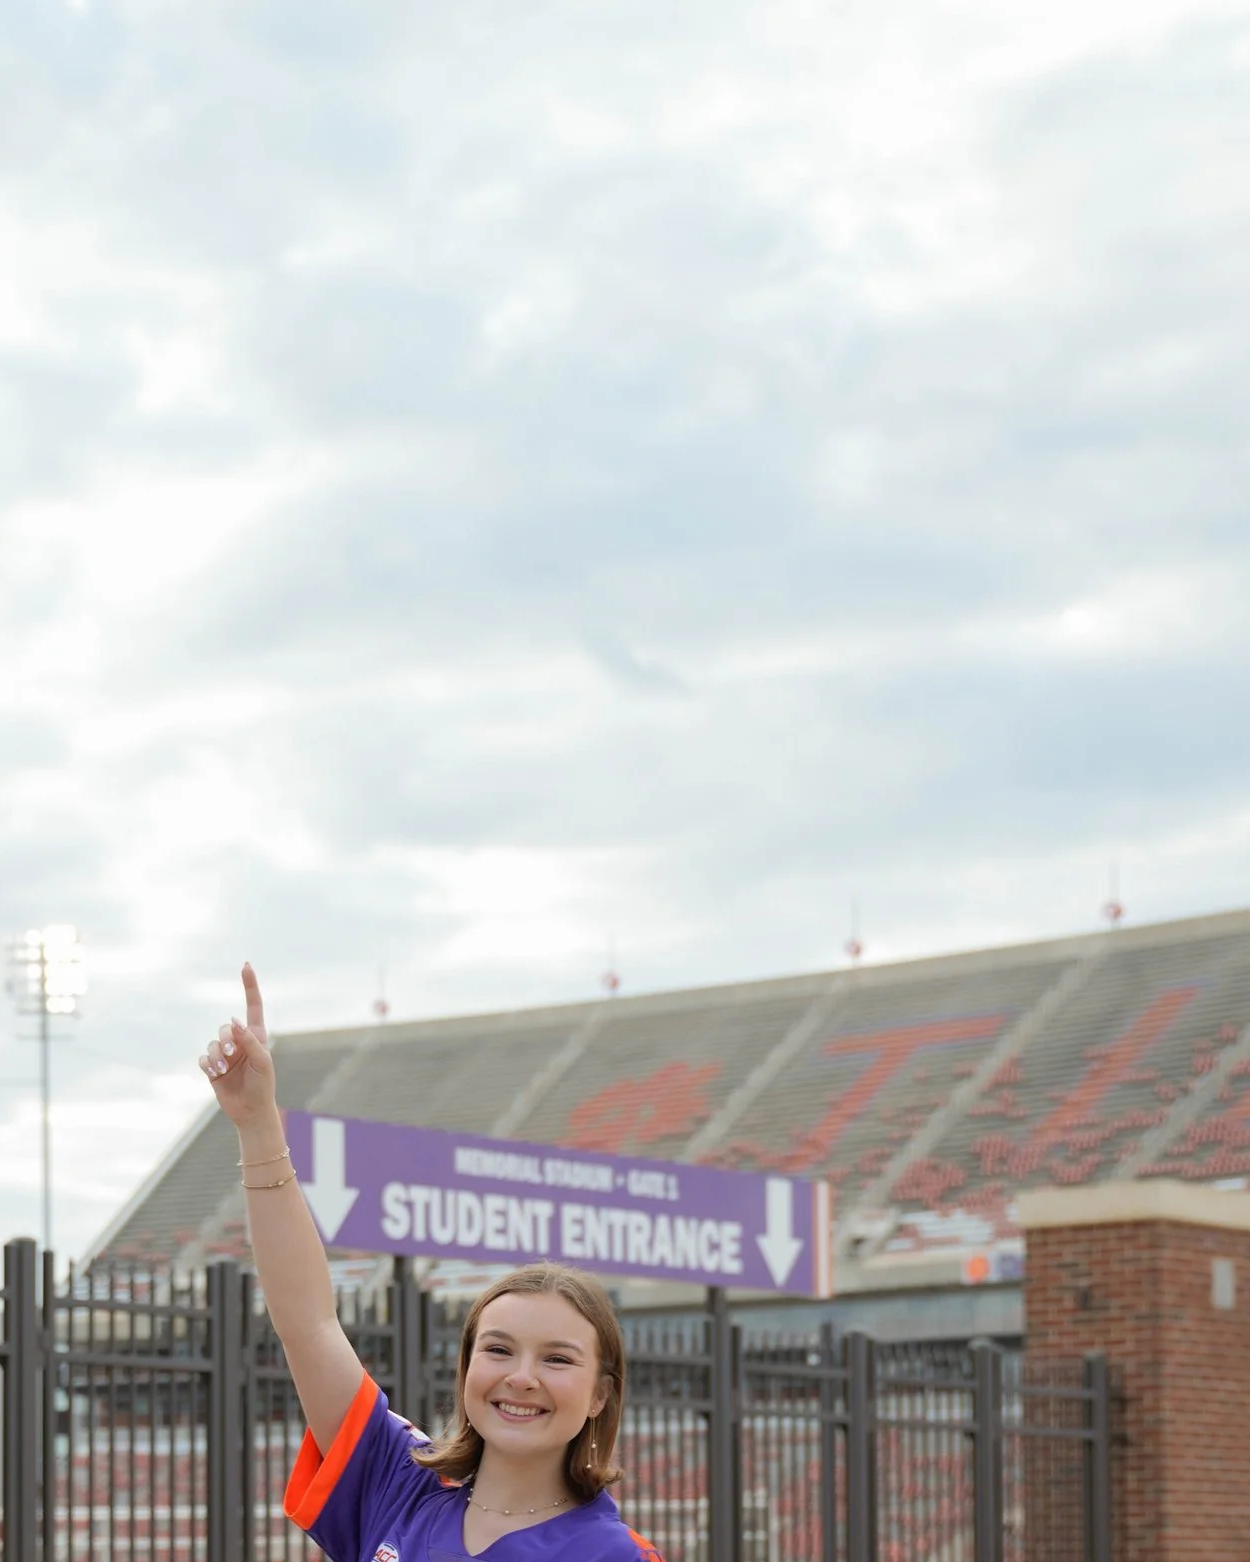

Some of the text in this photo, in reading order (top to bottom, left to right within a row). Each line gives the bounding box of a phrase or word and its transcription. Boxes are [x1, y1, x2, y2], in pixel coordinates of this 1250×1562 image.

[454, 1146, 542, 1184] MEMORIAL
[543, 1157, 614, 1192] STADIUM
[627, 1168, 668, 1200] GATE
[381, 1181, 744, 1275] STUDENT ENTRANCE
